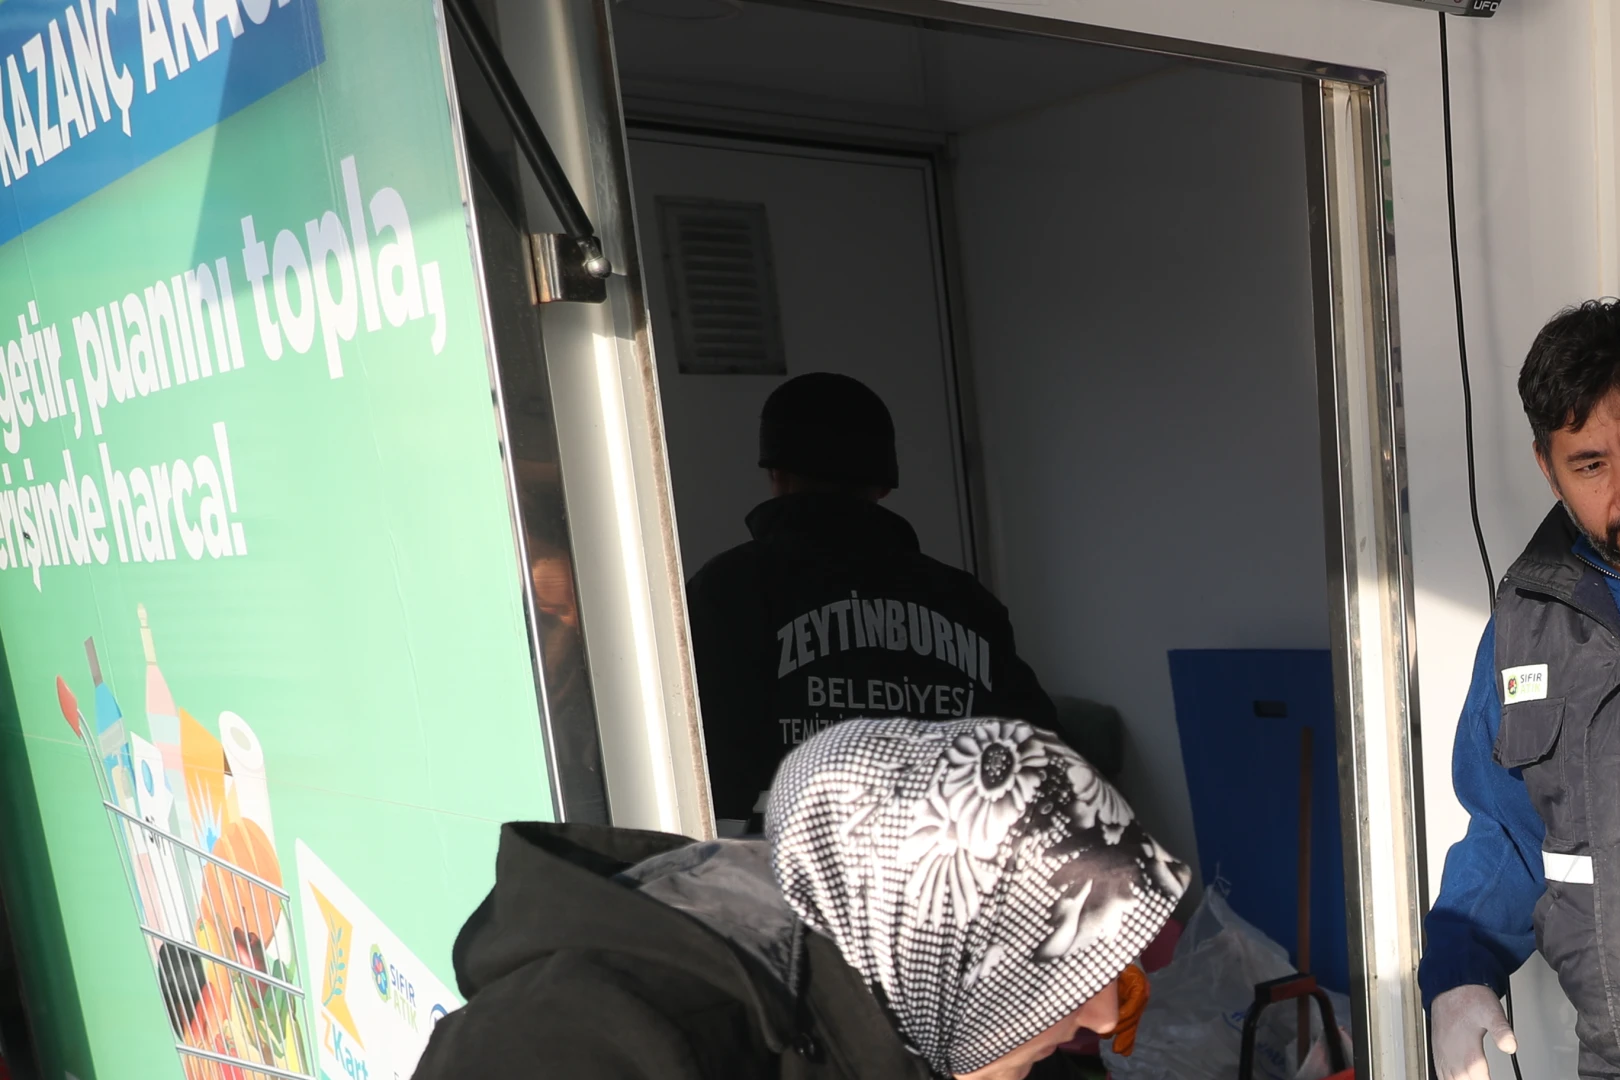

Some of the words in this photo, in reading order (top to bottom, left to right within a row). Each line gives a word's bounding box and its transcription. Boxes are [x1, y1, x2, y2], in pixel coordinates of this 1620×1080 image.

[0, 0, 134, 187] AZANÇ
[72, 256, 245, 436] puanını
[241, 155, 447, 379] topla,
[0, 448, 110, 593] rişinde
[98, 421, 248, 563] harca!
[808, 675, 974, 718] BELEDİYESİ
[1520, 672, 1543, 684] SIFIR
[390, 963, 417, 1008] SIFIR
